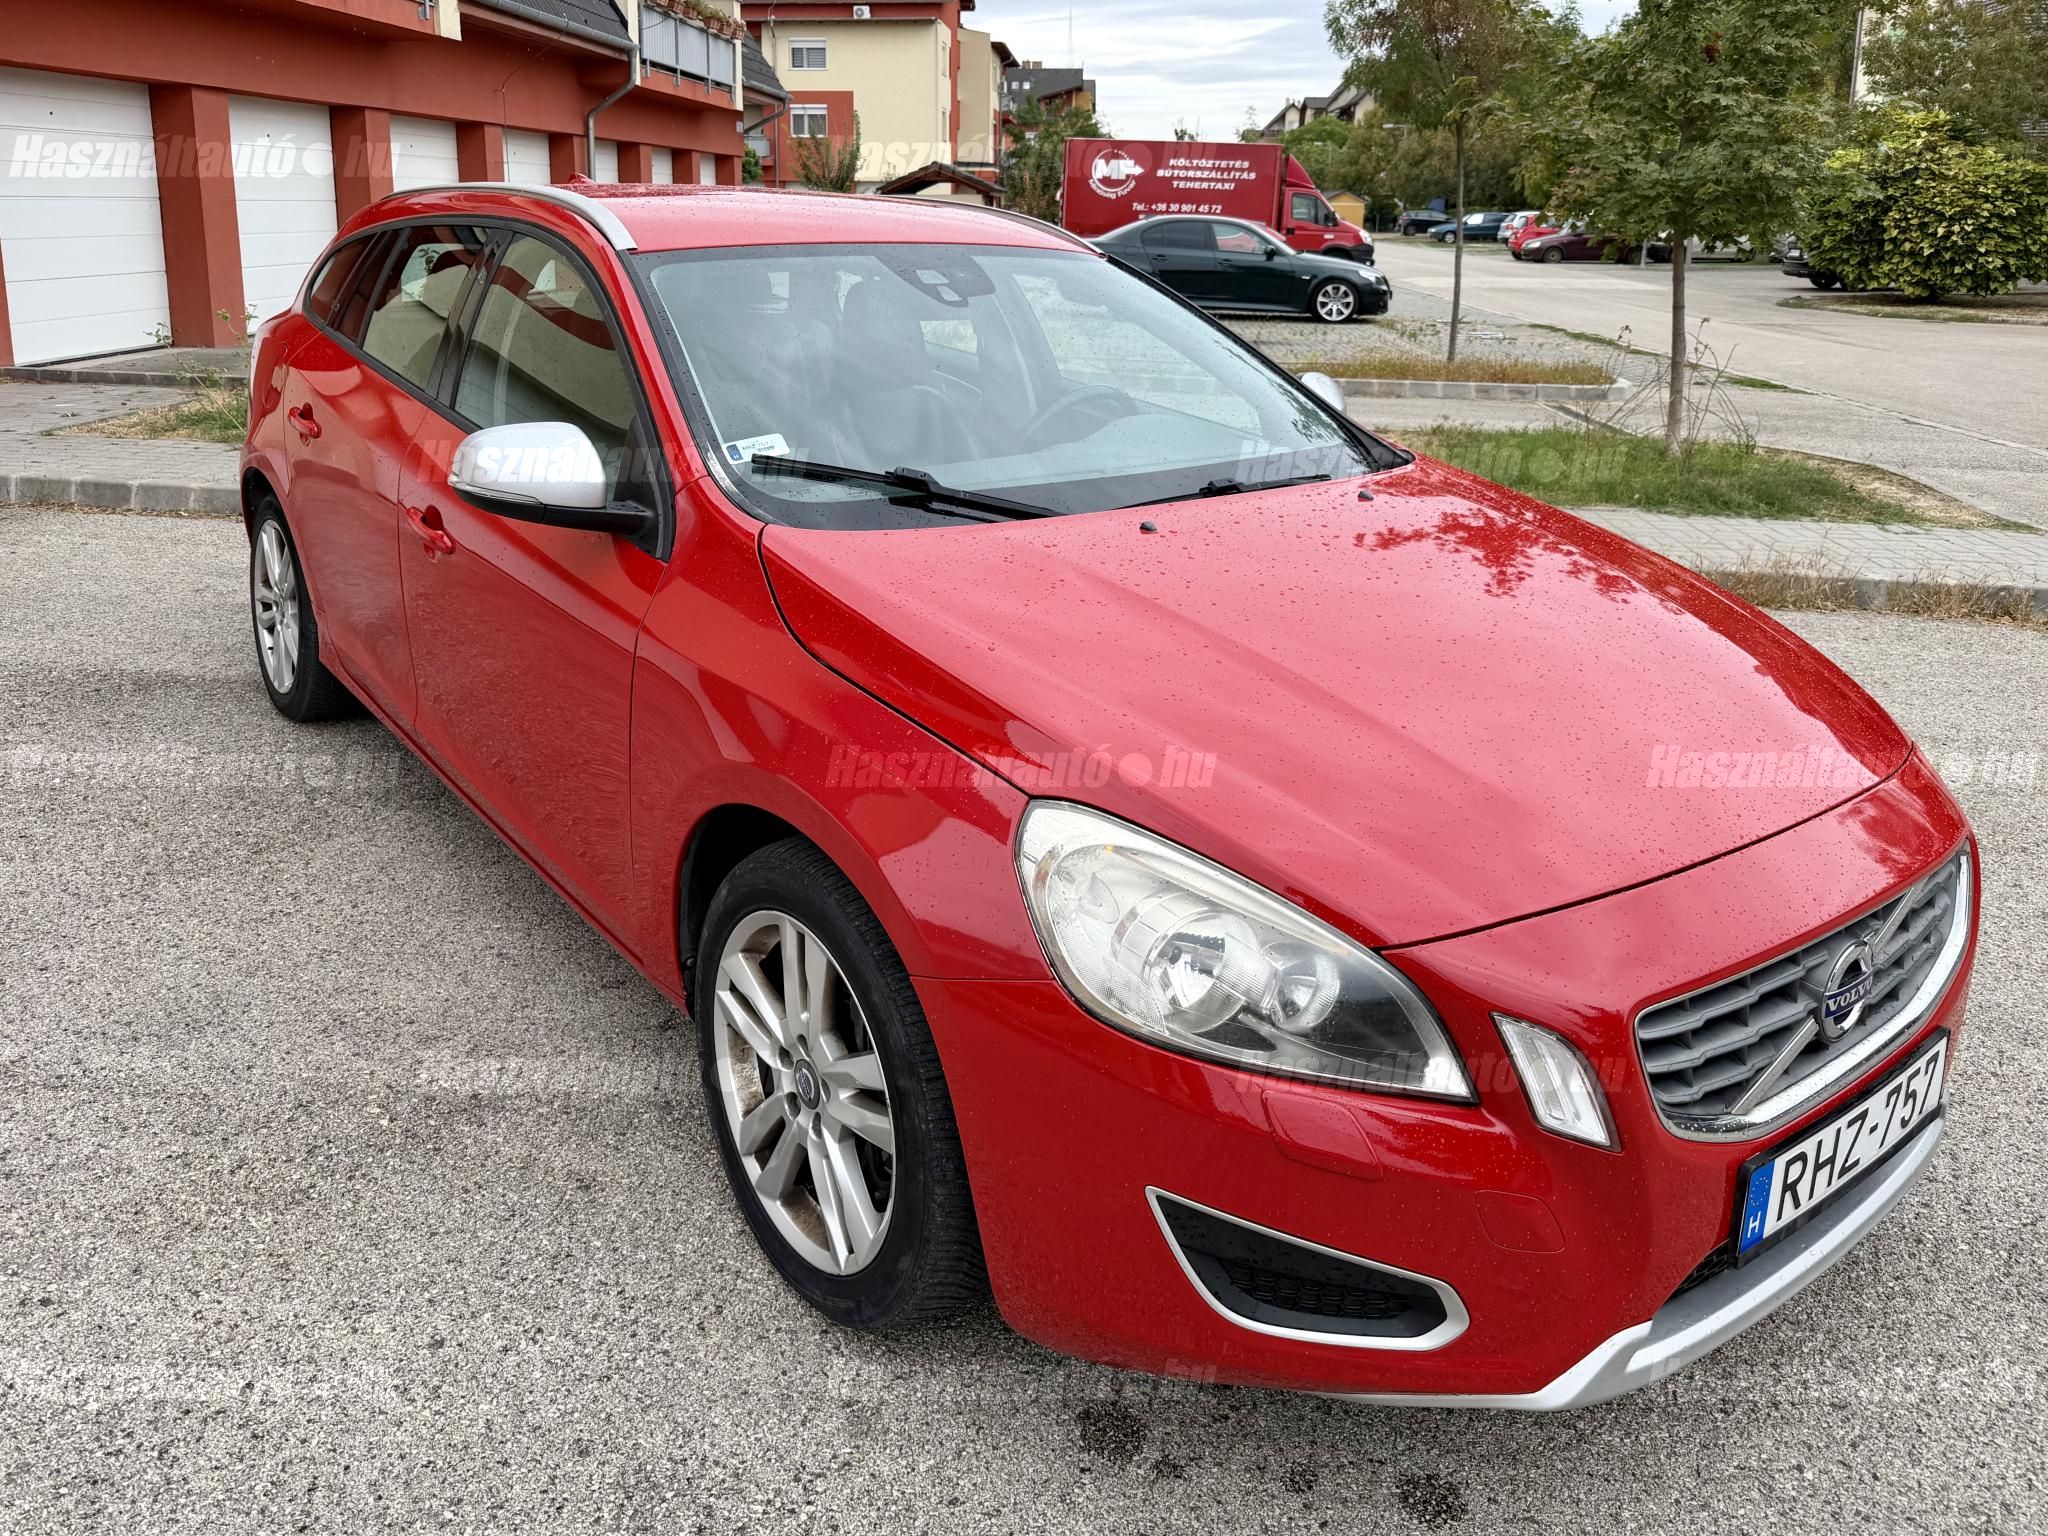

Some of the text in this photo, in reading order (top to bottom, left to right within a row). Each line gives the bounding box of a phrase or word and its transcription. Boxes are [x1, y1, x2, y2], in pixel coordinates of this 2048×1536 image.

[1171, 181, 1235, 190] TEHERTAXI
[1151, 202, 1167, 211] +36
[1168, 203, 1179, 212] 30
[1180, 204, 1196, 212] 901
[1198, 204, 1209, 213] 45
[1210, 204, 1223, 214] 72
[1826, 975, 1873, 1012] VOLVO
[1776, 1049, 1940, 1222] RHZ-757
[1747, 1211, 1761, 1239] H
